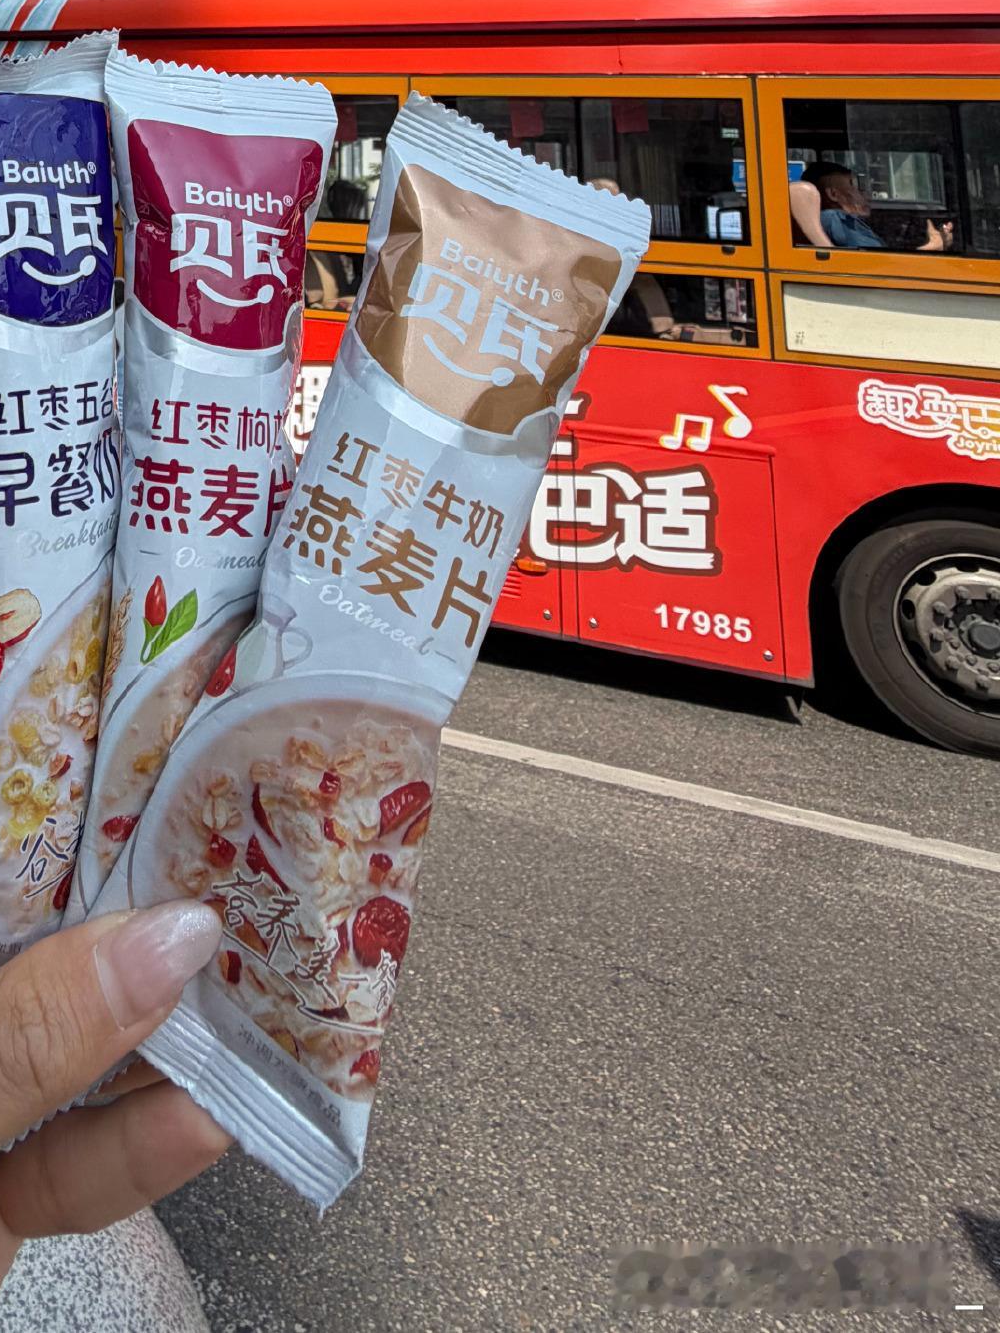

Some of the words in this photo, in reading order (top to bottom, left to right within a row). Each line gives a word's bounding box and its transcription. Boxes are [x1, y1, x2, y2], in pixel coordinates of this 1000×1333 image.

[170, 212, 289, 287] 贝氏
[400, 262, 559, 386] 贝氏
[955, 436, 1000, 454] Joyri
[326, 432, 505, 559] 红枣牛奶
[283, 484, 493, 648] 燕麦片
[319, 585, 436, 656] Oatmeal
[654, 603, 752, 643] 17985
